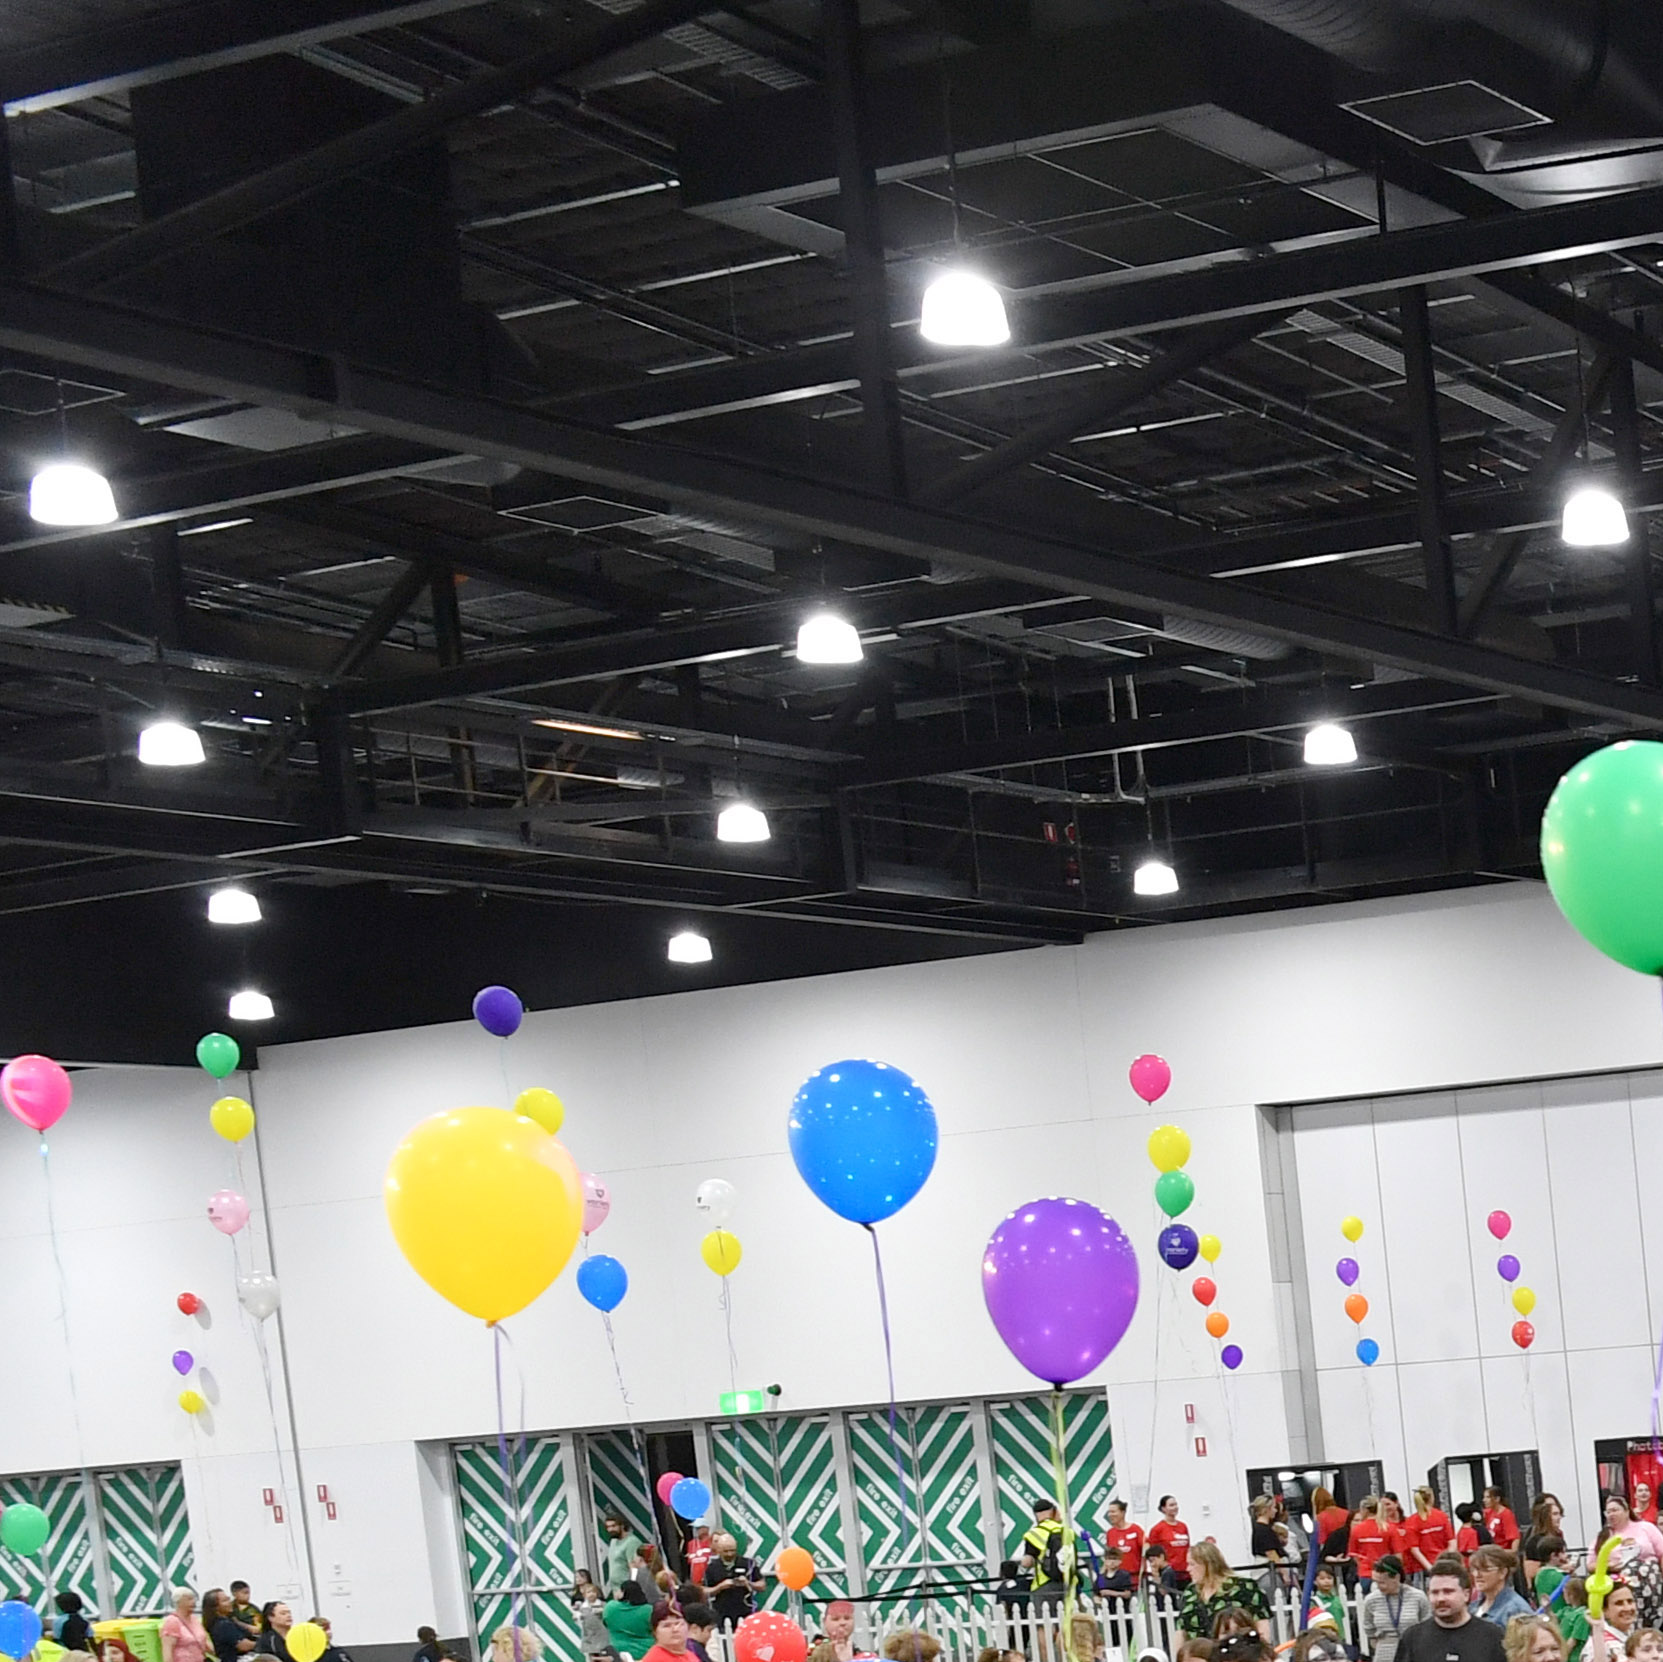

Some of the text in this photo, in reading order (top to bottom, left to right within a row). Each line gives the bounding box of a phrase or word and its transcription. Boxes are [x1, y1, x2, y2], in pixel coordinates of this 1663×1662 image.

[946, 1474, 975, 1514] fire exit
[1007, 1474, 1023, 1493] fire
[1092, 1485, 1108, 1504] fire
[806, 1487, 834, 1527] fire exit
[865, 1483, 899, 1519] fire exit
[469, 1512, 501, 1547] fire exit
[540, 1509, 567, 1546] fire exit
[812, 1550, 828, 1568] fire
[951, 1541, 967, 1560] fire
[549, 1568, 564, 1585] fire
